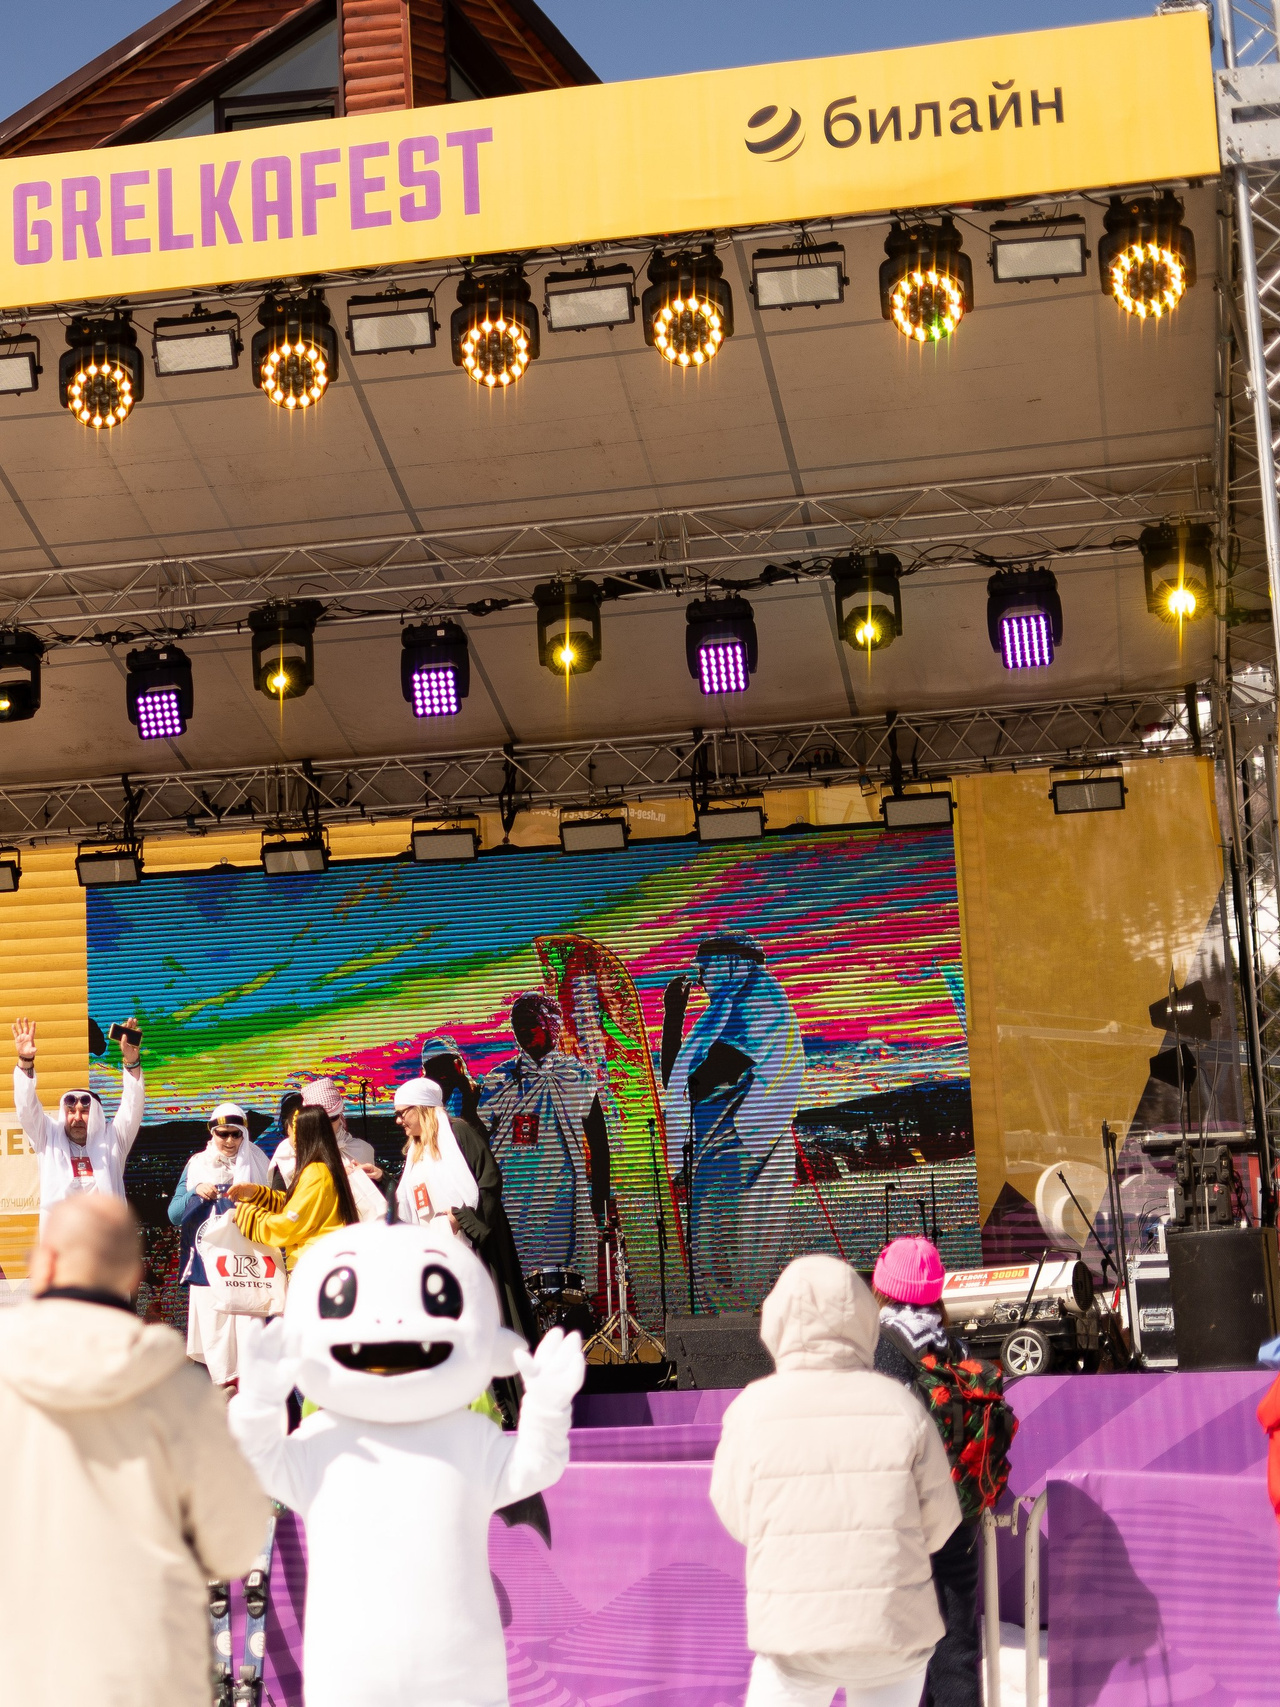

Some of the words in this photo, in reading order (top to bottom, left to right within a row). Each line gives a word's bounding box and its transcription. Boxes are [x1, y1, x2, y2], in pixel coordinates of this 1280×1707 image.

[823, 79, 1065, 149] билайн
[12, 127, 494, 266] GRELKAFEST
[1166, 1004, 1194, 1013] SURE
[233, 1255, 261, 1279] R
[991, 1269, 1025, 1280] 30000
[225, 1281, 273, 1289] ROSTIC'S
